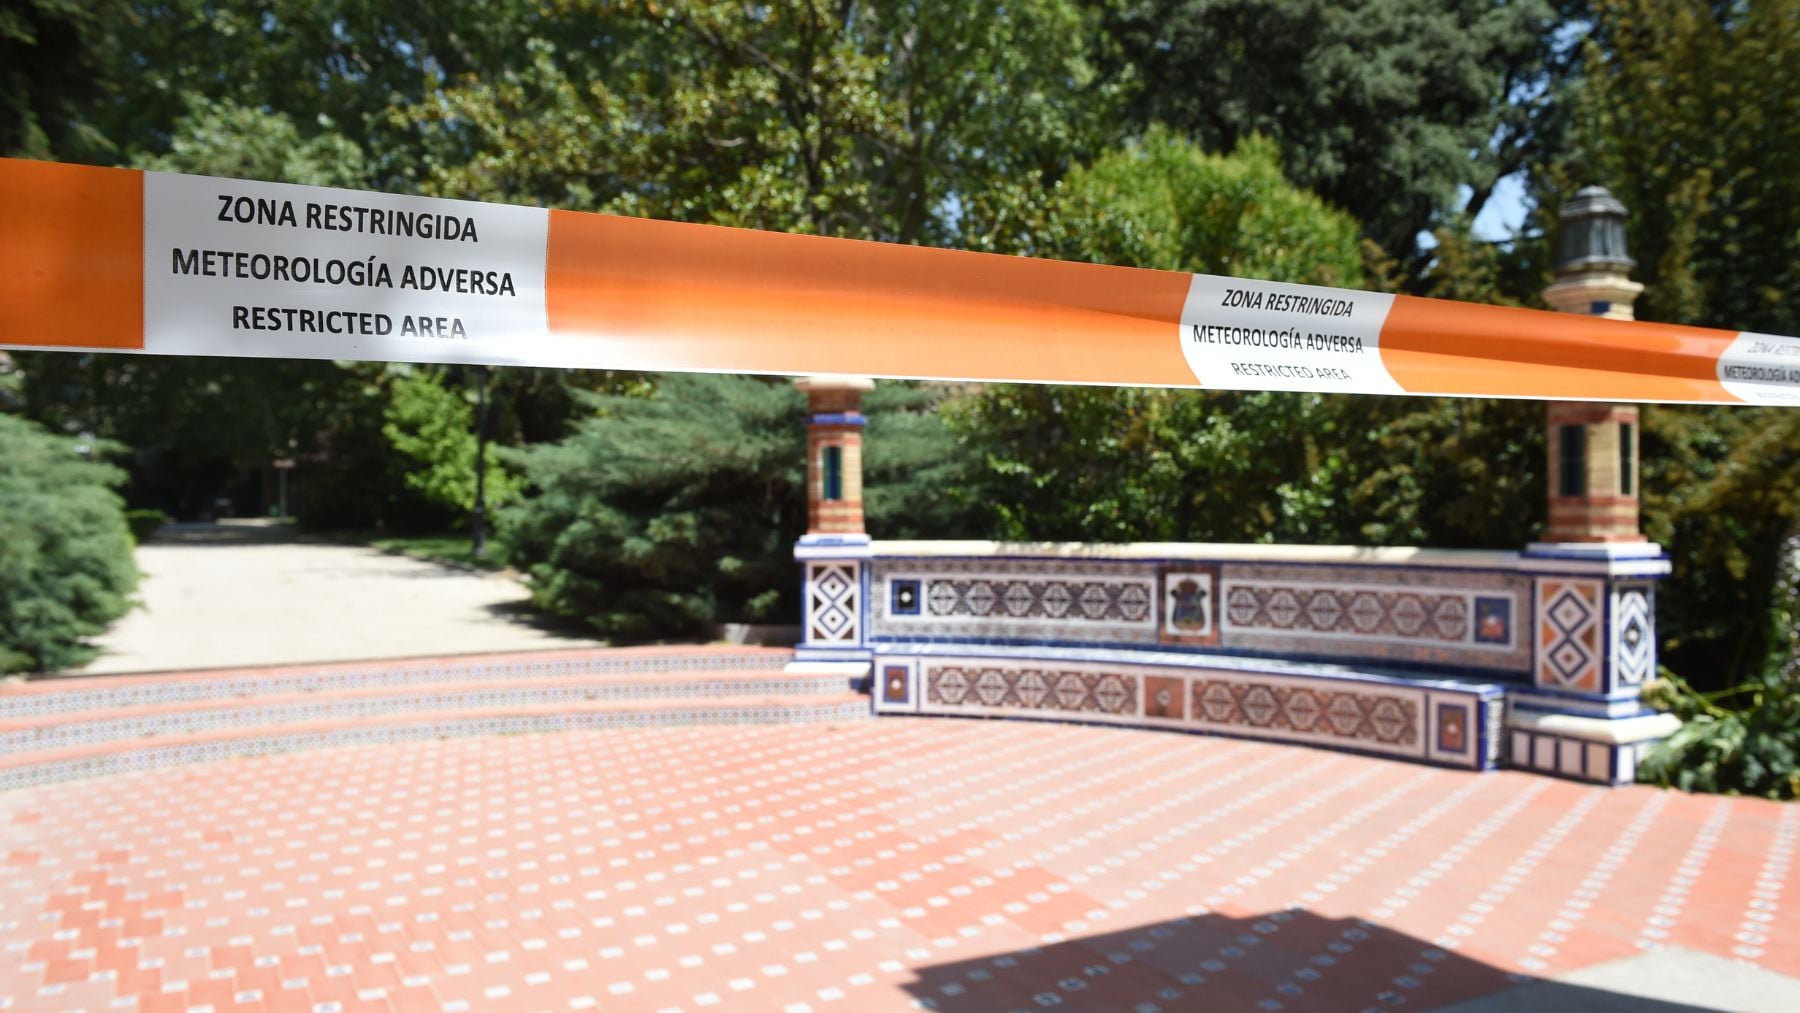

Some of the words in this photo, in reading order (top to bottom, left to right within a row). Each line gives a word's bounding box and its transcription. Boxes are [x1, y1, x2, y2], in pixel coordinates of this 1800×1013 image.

[217, 194, 297, 227] ZONA
[306, 203, 478, 242] RESTRINGIDA
[172, 248, 393, 288] METEOROLOGÍA
[400, 265, 516, 297] ADVERSA
[1221, 289, 1263, 309] ZONA
[1265, 293, 1353, 317] RESTRINGIDA
[232, 305, 392, 336] RESTRICTED
[400, 315, 467, 339] AREA
[1193, 324, 1302, 349] METEOROLOGÍA
[1306, 333, 1363, 353] ADVERSA
[1231, 362, 1314, 379] RESTRICTED
[1316, 367, 1352, 380] AREA
